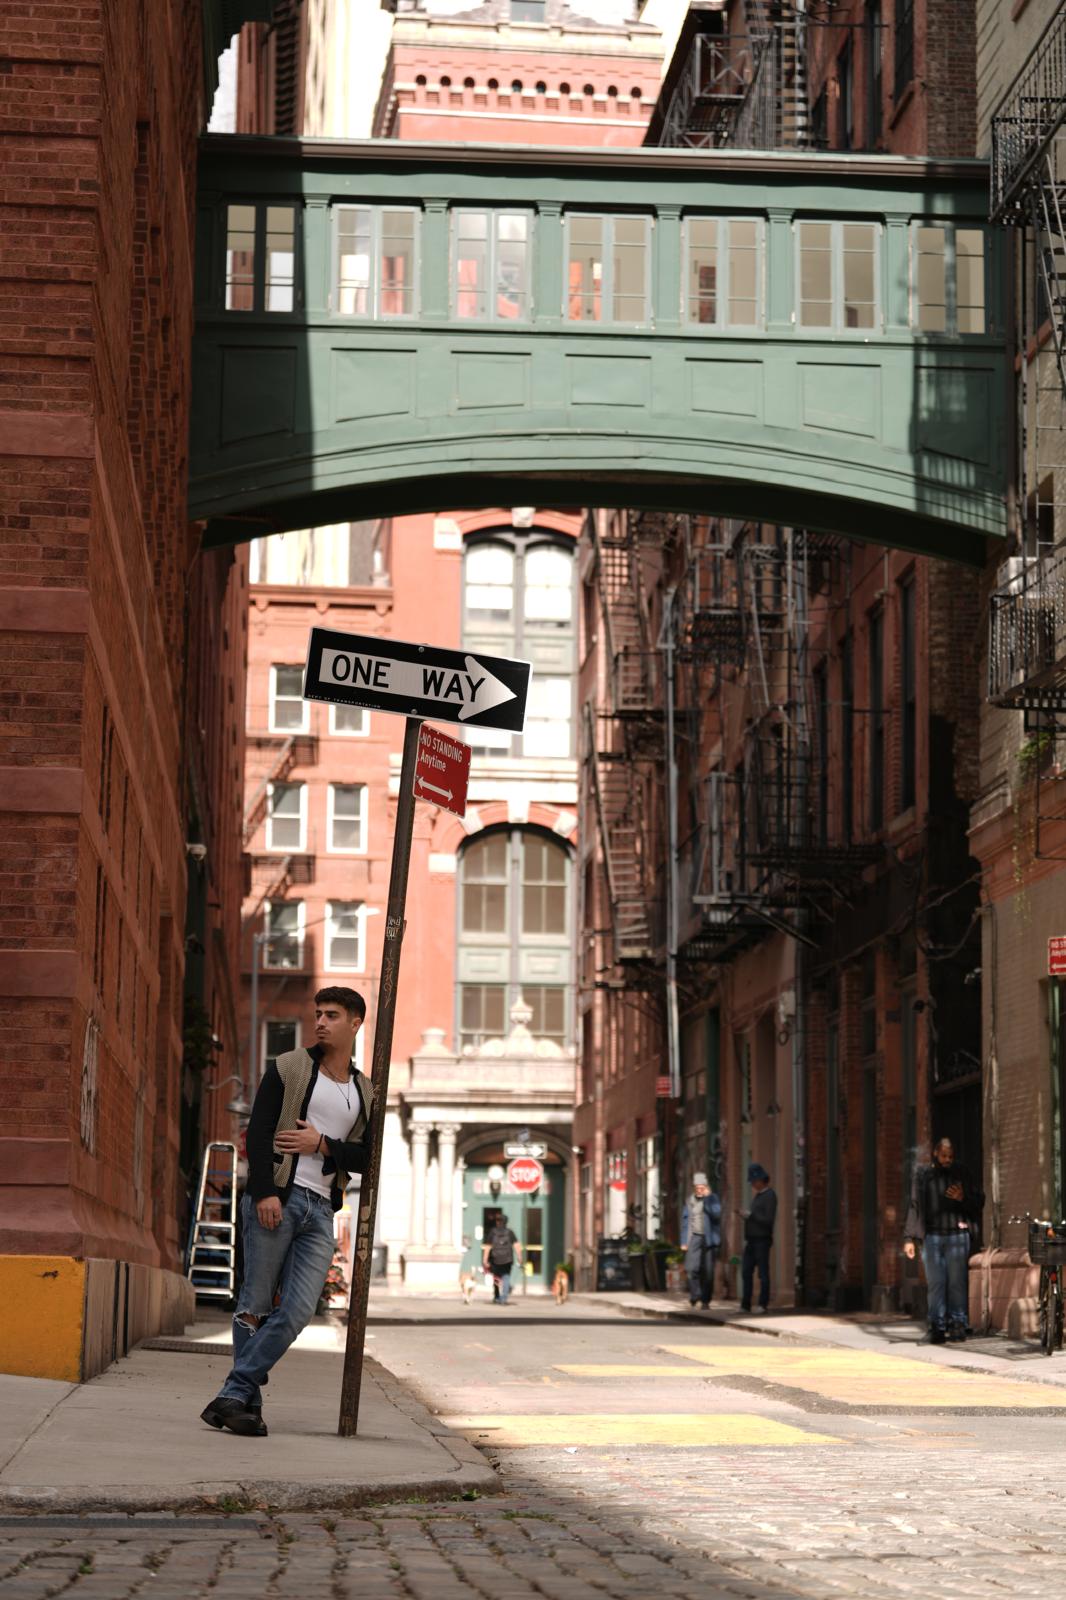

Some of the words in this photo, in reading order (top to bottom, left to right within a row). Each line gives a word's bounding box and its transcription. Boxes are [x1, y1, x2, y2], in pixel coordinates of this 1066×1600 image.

[332, 654, 391, 688] ONE
[422, 668, 486, 702] WAY
[420, 748, 447, 772] Anytime
[421, 732, 432, 747] NO
[432, 737, 463, 763] STANDING
[511, 1167, 539, 1182] STOP
